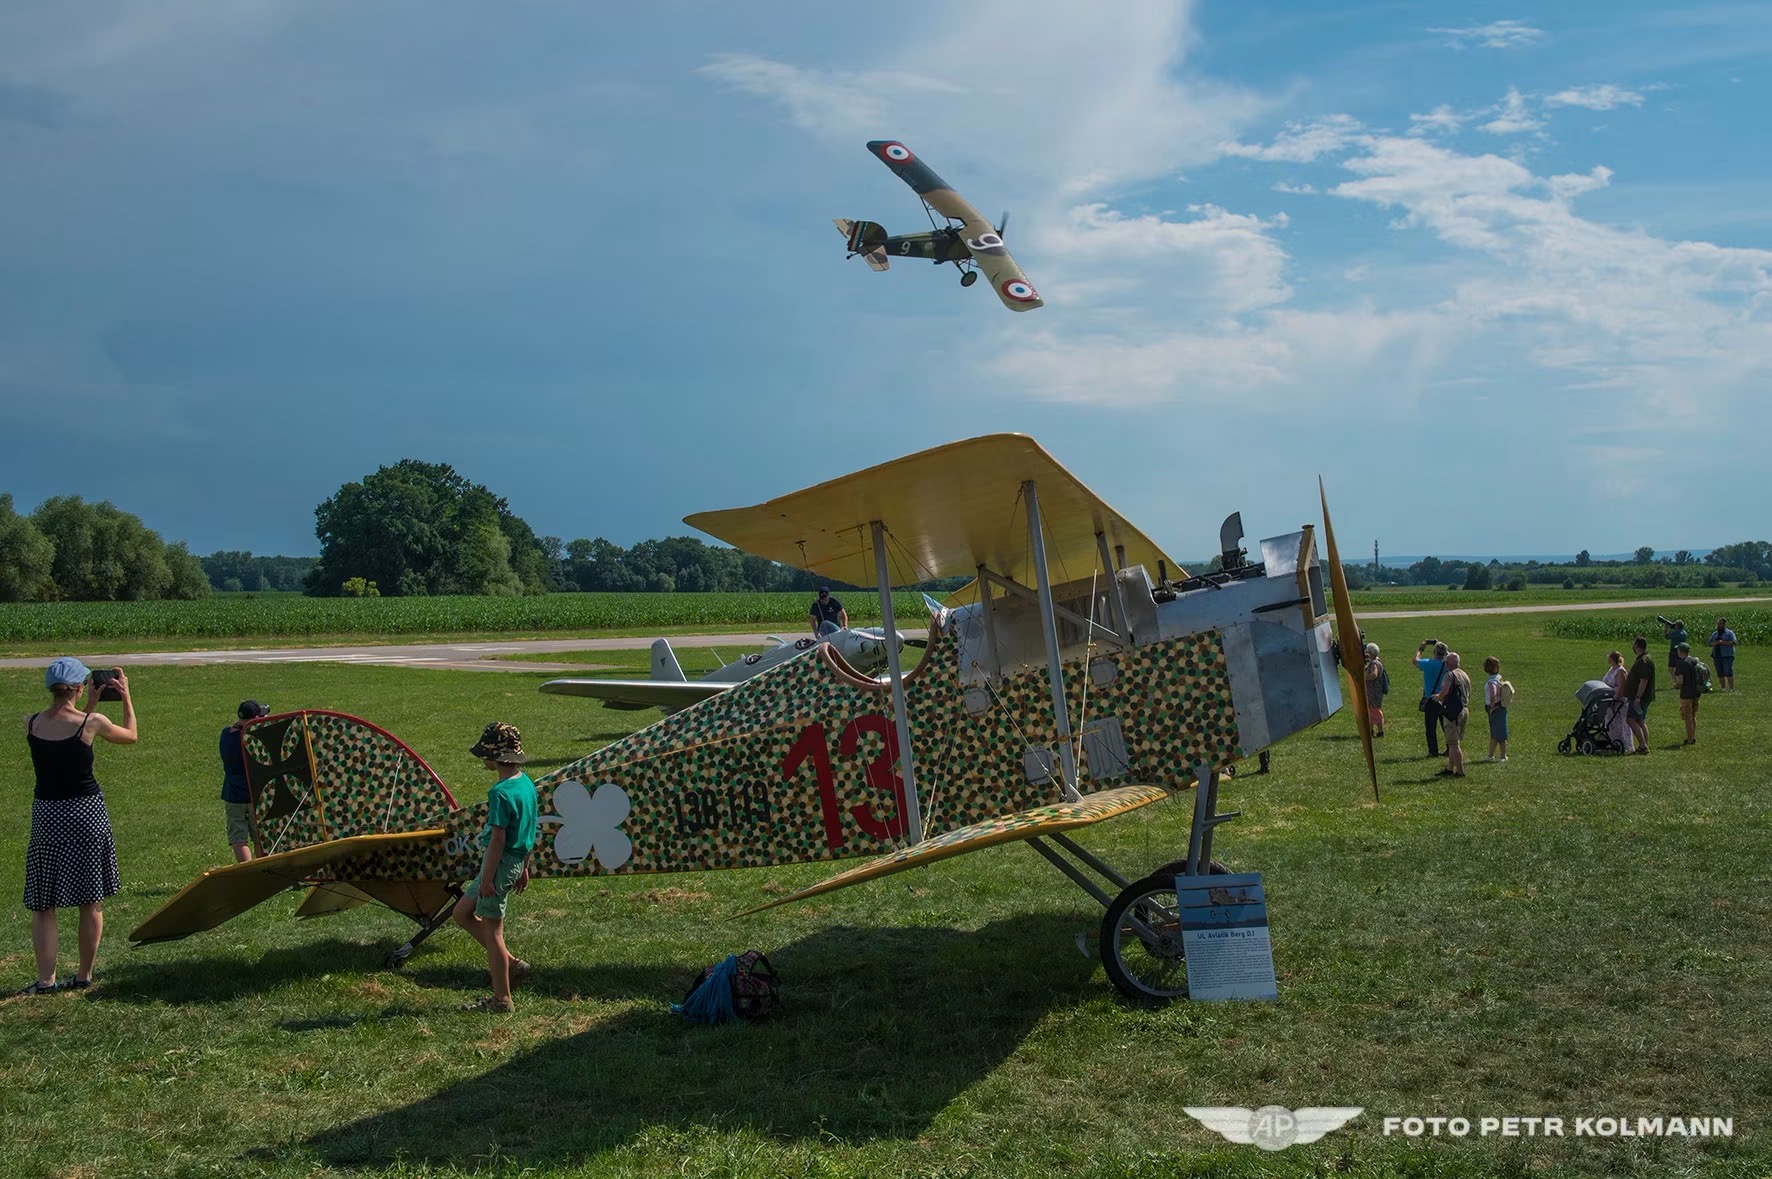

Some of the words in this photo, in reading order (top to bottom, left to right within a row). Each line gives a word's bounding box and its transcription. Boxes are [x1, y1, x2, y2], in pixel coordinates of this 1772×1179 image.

[900, 241, 911, 255] 9
[967, 234, 1004, 250] 9
[782, 714, 910, 850] 13
[444, 834, 473, 856] OK
